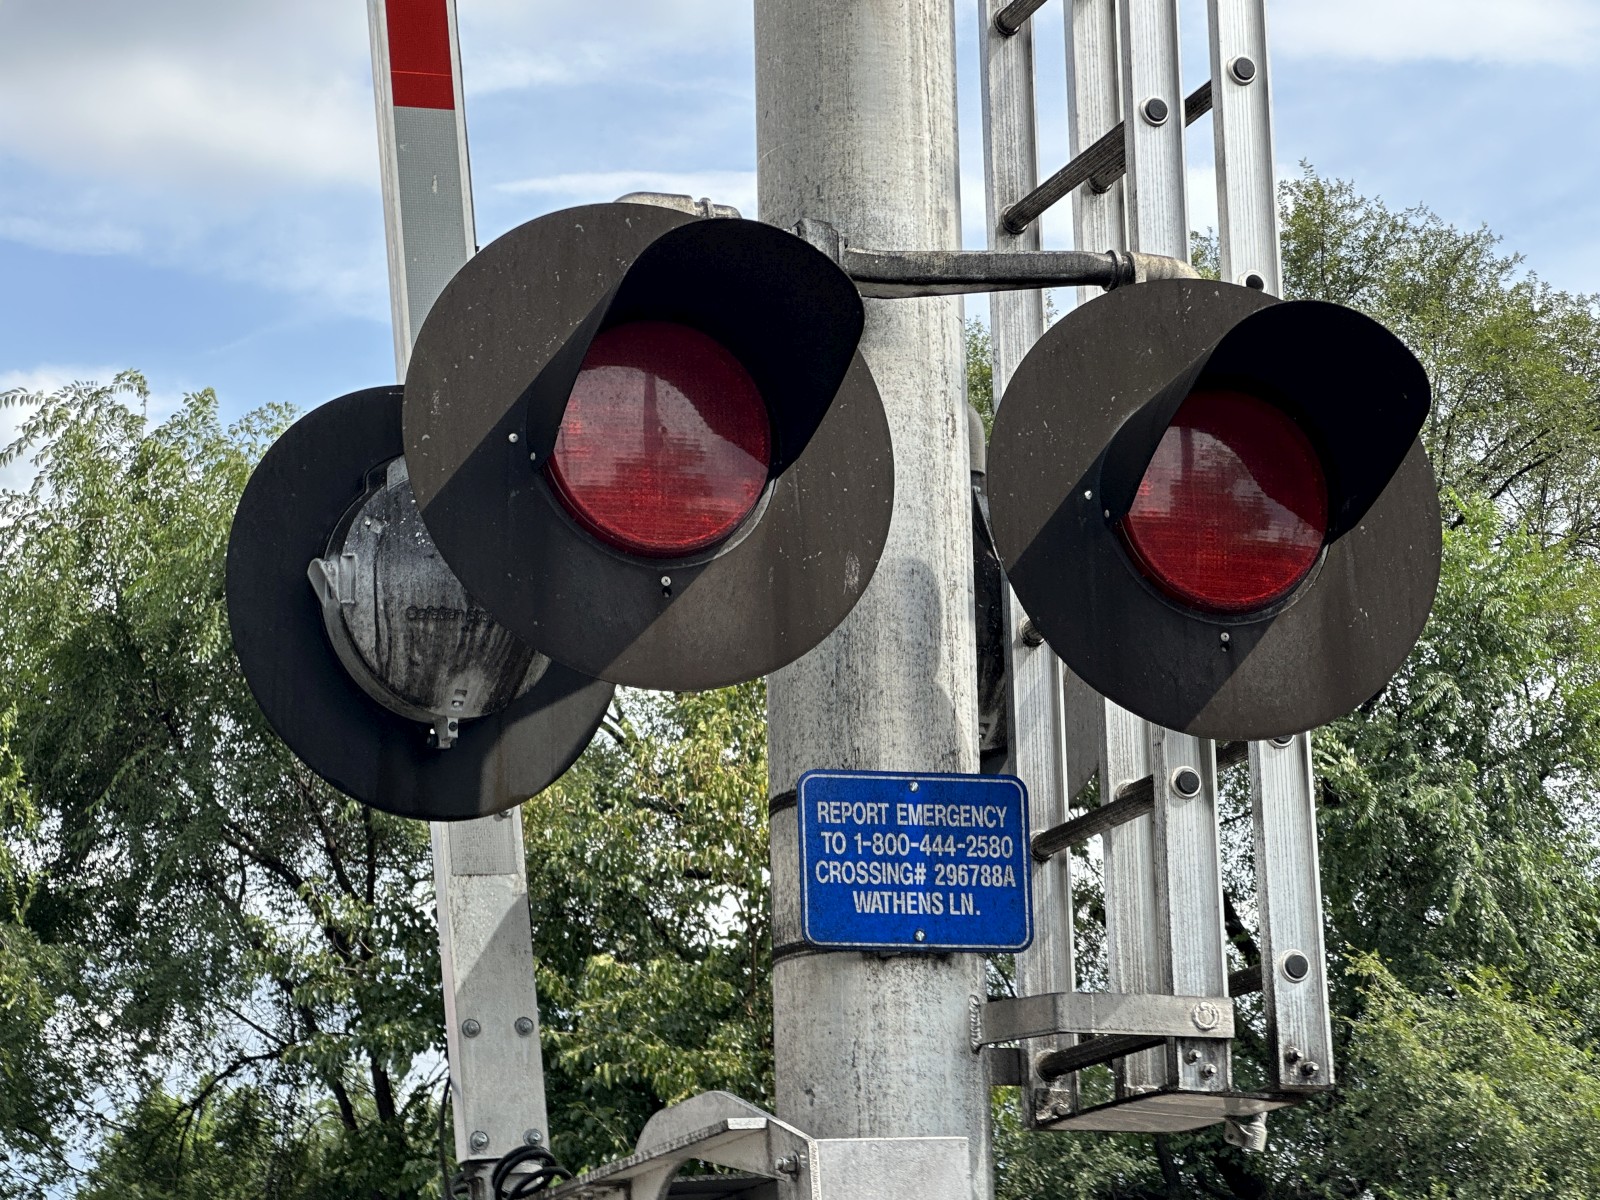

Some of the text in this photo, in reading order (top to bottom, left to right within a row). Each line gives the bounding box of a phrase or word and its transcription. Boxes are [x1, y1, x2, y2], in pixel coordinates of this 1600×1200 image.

[817, 801, 1007, 828] REPORT EMERGENCY
[820, 831, 1013, 859] TO 1-800-444-2580
[815, 860, 1016, 887] CROSSING# 296788A
[852, 890, 981, 916] WATHENS LN.
